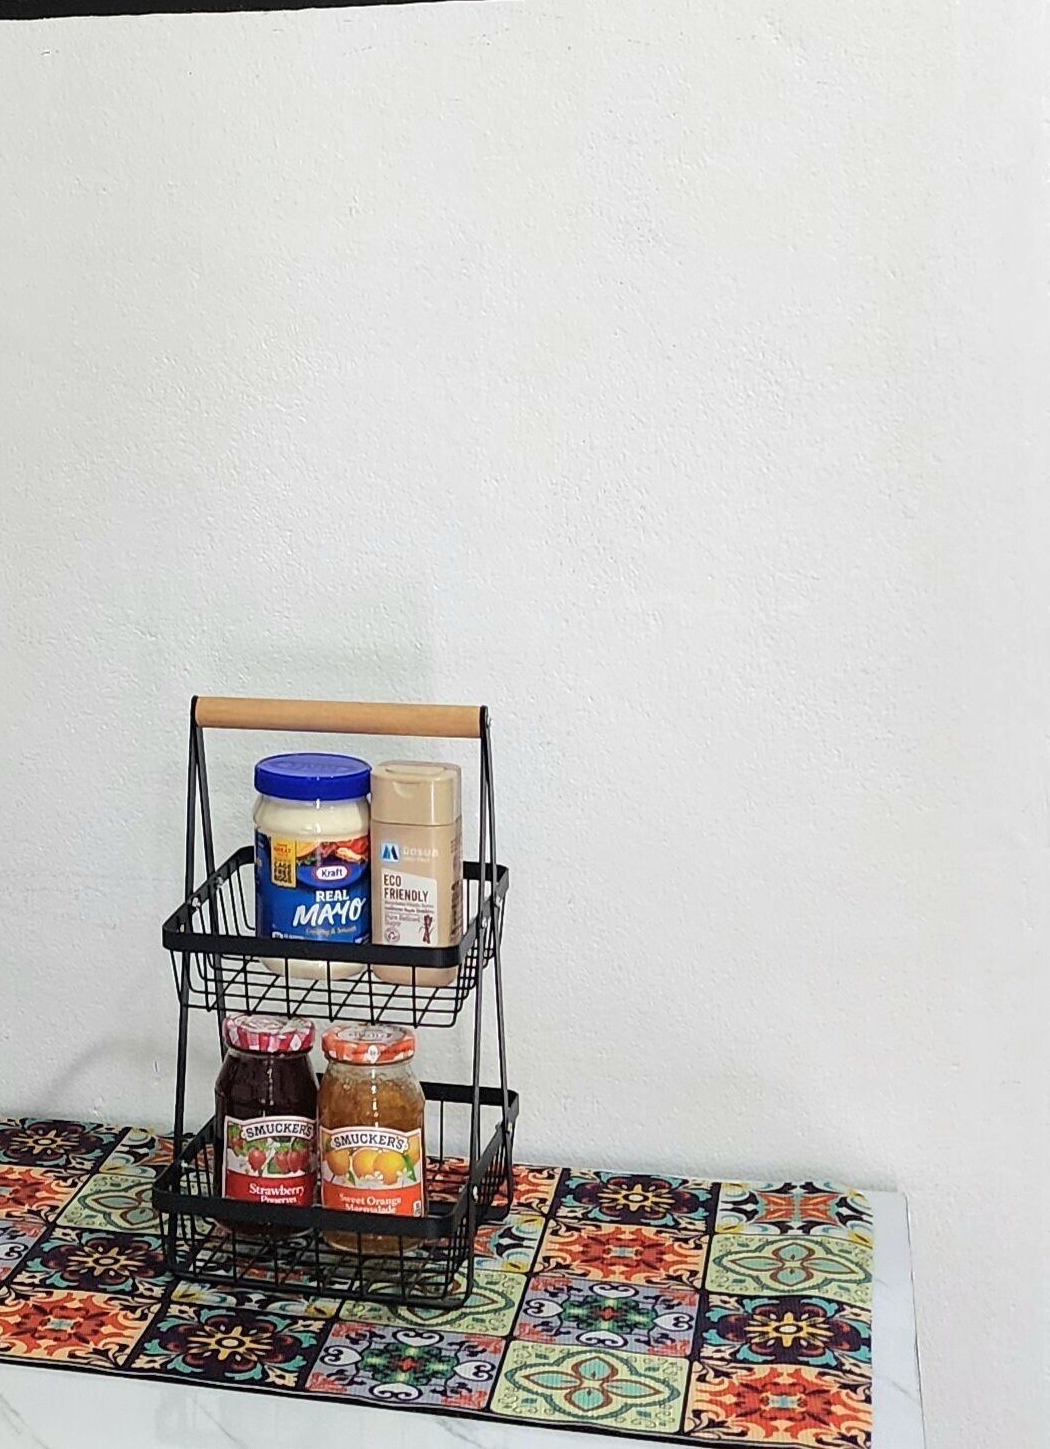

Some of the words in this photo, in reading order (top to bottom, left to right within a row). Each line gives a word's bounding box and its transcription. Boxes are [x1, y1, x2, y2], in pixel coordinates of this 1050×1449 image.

[321, 866, 343, 880] Kraft
[383, 873, 402, 887] ECO
[315, 889, 350, 902] REAL
[384, 887, 429, 903] FRIENDLY
[292, 897, 366, 927] MAYO
[333, 1132, 405, 1150] SMUCKER'S
[249, 1182, 304, 1197] Strawberry
[366, 1196, 402, 1206] Orange
